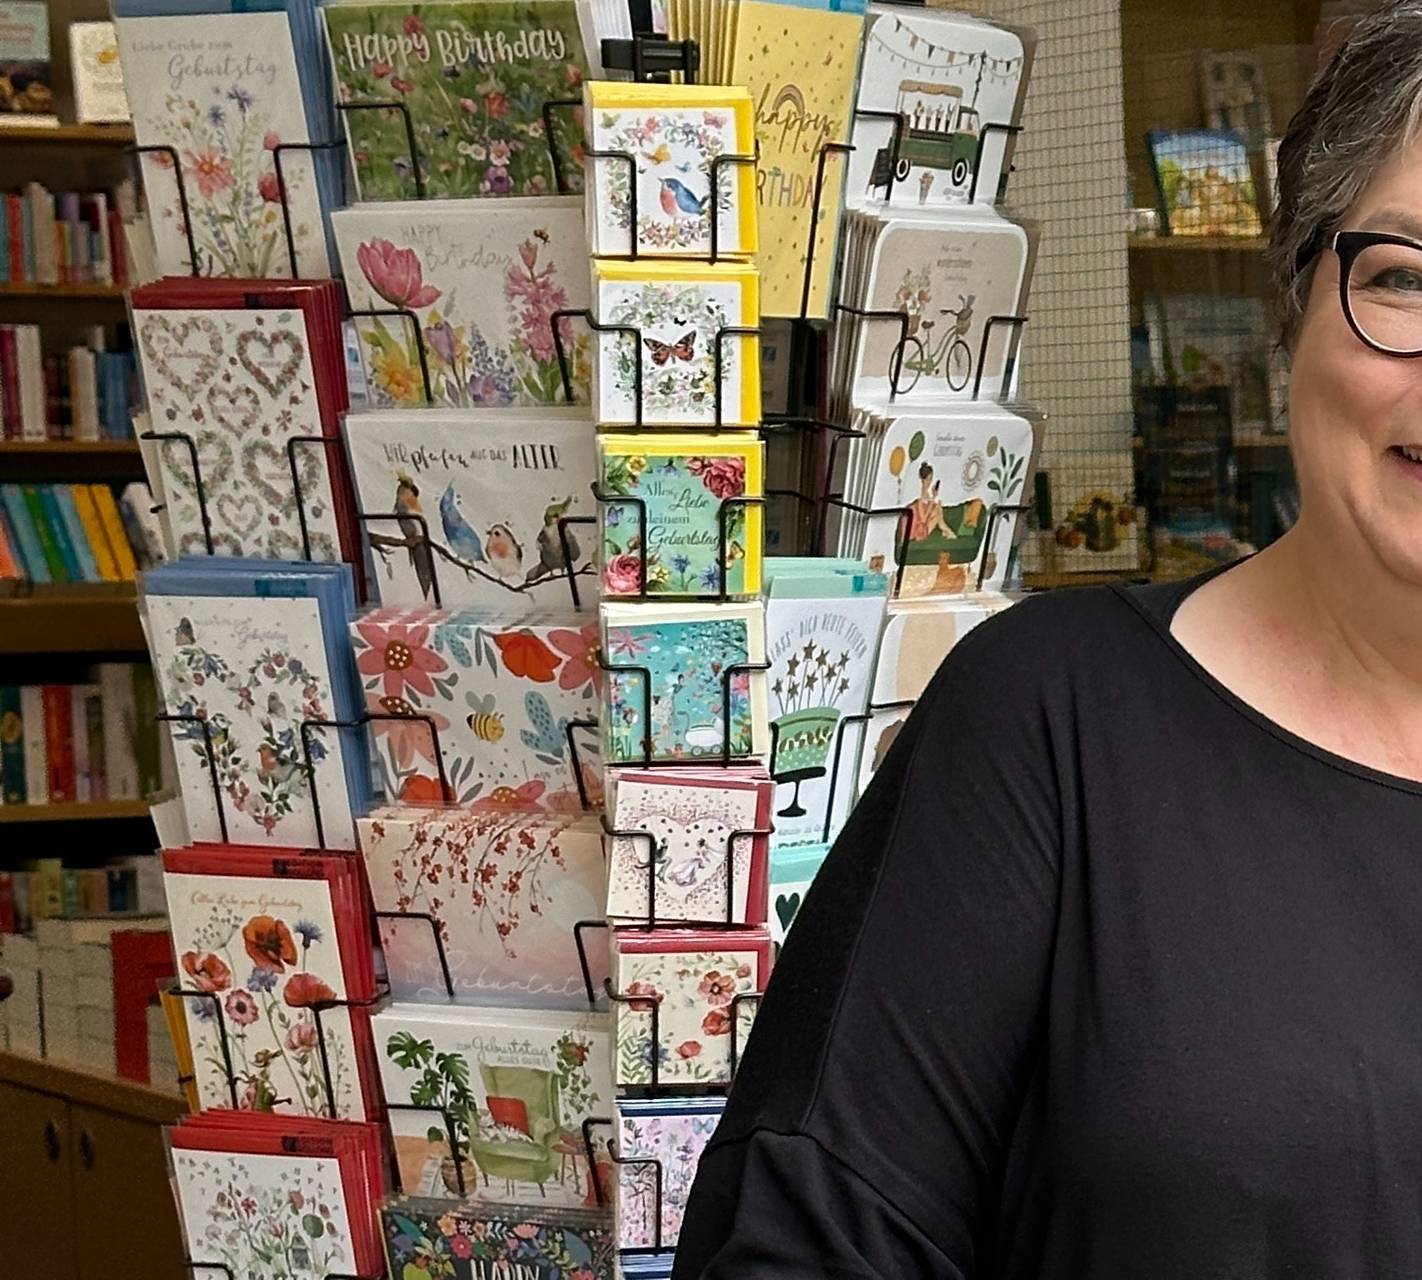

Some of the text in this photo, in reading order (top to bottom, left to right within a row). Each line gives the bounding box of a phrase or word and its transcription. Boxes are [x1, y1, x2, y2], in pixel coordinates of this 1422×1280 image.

[343, 29, 566, 72] Happy Birthday
[168, 53, 277, 91] Geburtstag
[472, 1036, 550, 1067] Geburtstag
